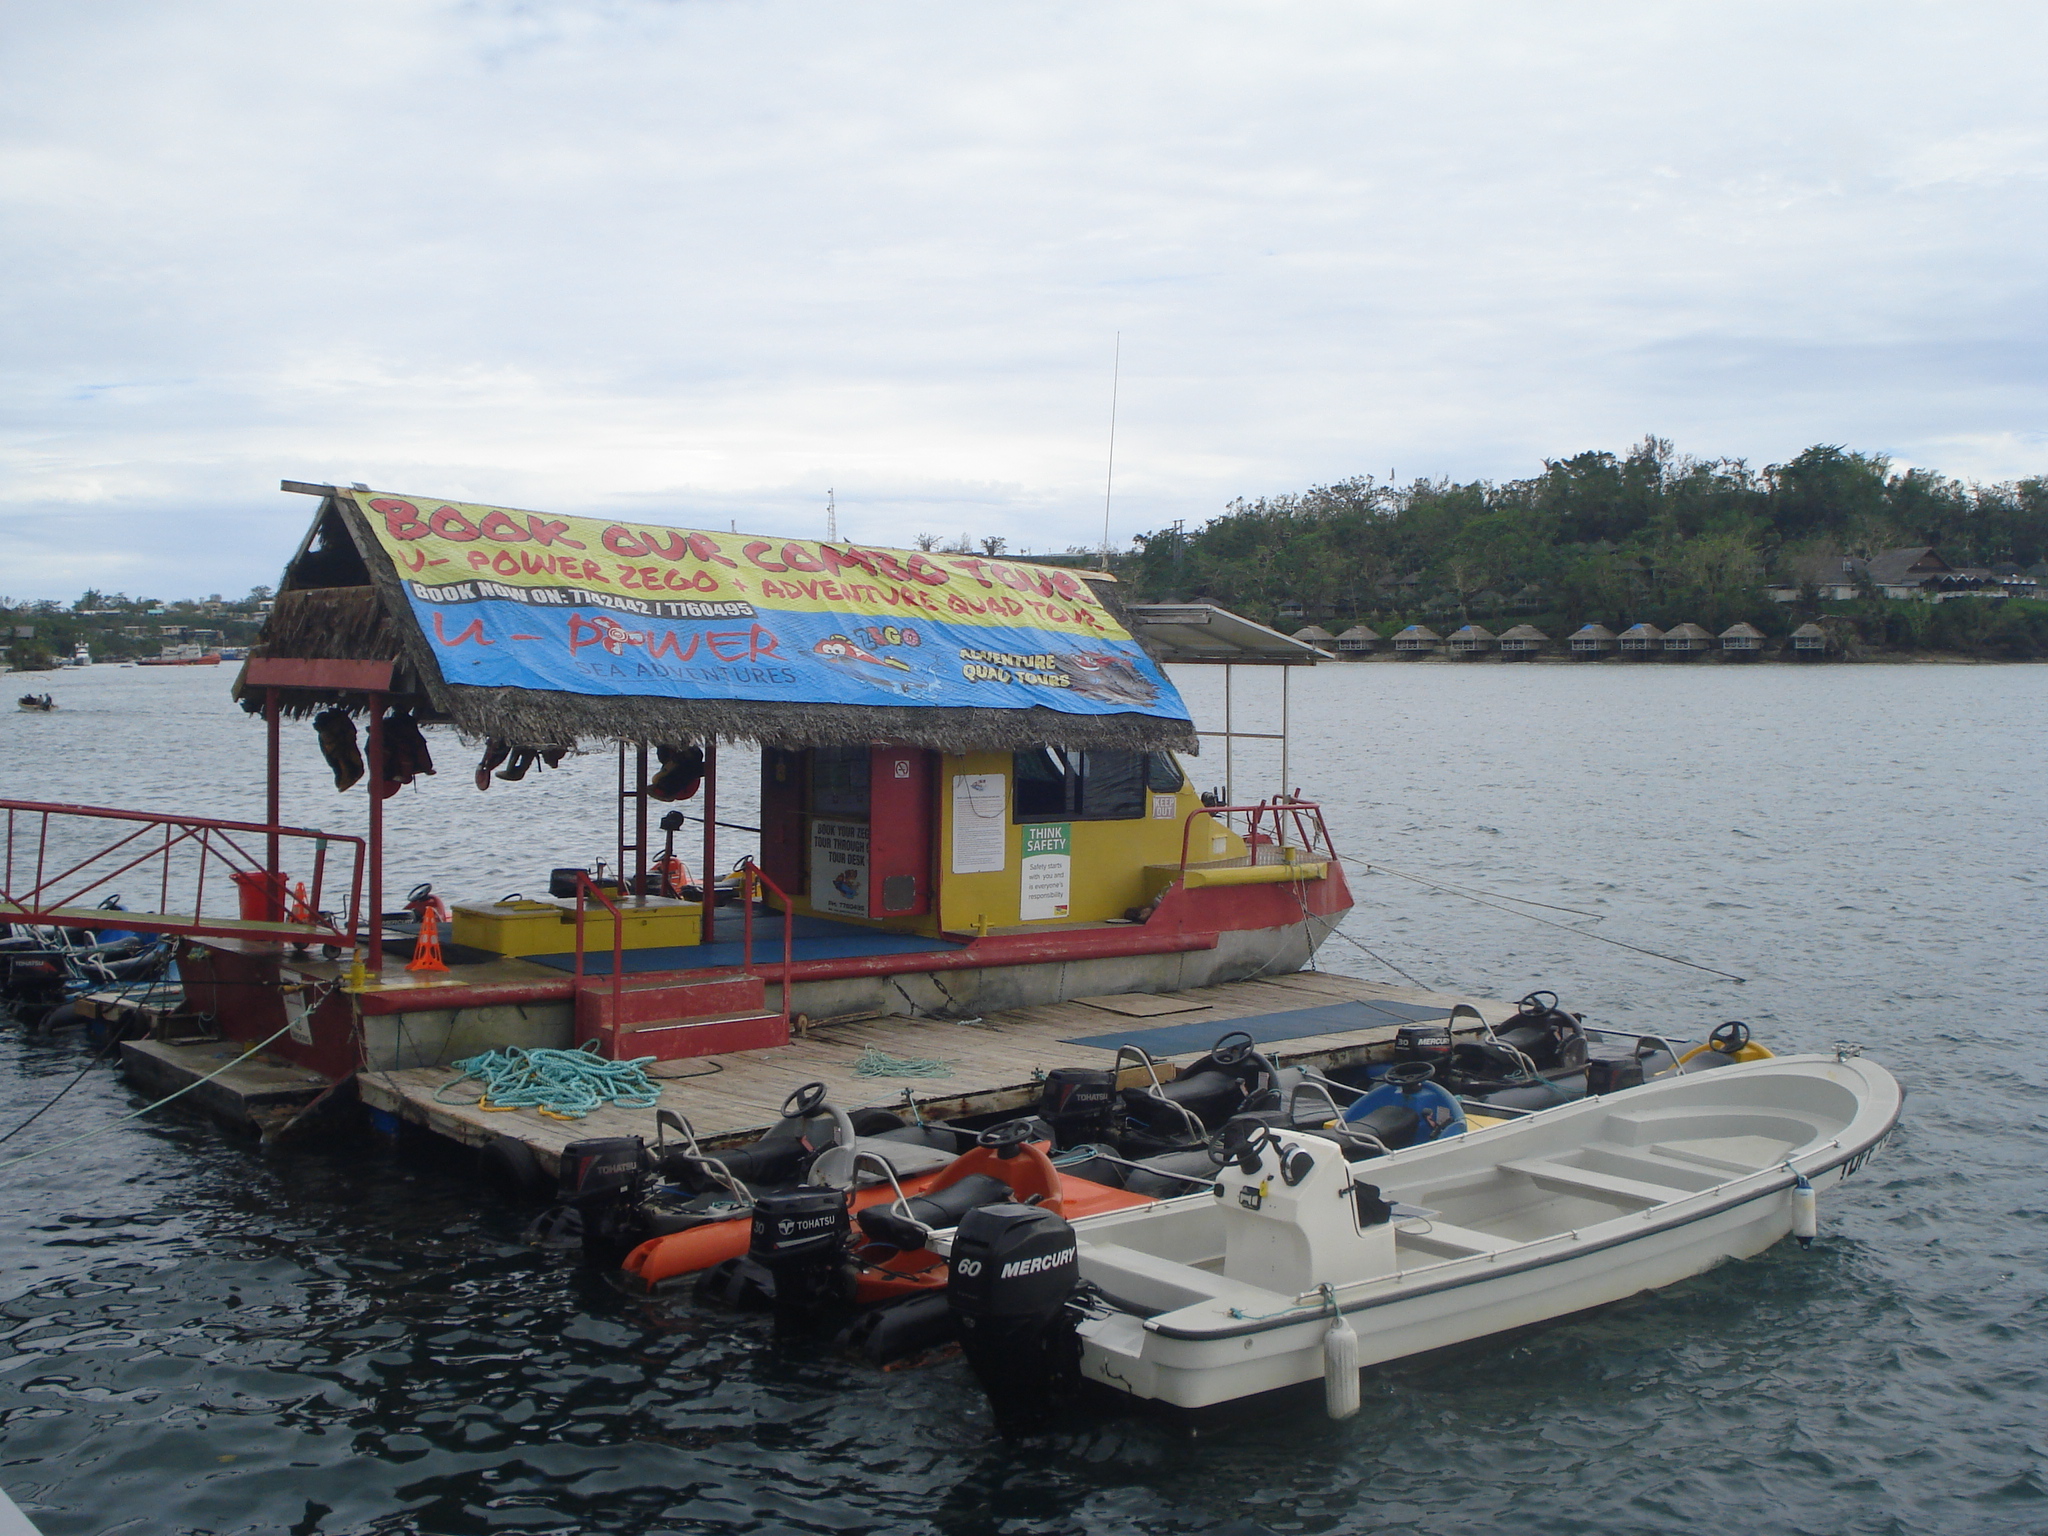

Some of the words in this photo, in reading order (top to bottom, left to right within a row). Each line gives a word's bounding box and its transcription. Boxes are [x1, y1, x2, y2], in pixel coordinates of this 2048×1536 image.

[369, 498, 587, 551] BOOK
[601, 525, 738, 568] OUR
[743, 540, 949, 586] COMBO
[948, 558, 1097, 605] TOUR
[467, 550, 610, 584] POWER
[617, 564, 719, 593] ZEGO
[762, 578, 938, 612] ADVENTURE
[947, 593, 1024, 617] QUAD
[1025, 600, 1105, 631] TOUR
[412, 582, 476, 603] BOOK
[476, 581, 529, 602] NOW
[530, 588, 569, 604] ON:
[568, 588, 652, 616] 7742442
[664, 602, 754, 617] 7760495
[853, 625, 922, 651] ZEGO
[959, 648, 1056, 670] ADVENTURE
[575, 661, 627, 677] SEA
[637, 662, 797, 683] ADVENTURES
[963, 664, 1013, 683] QUAD
[1015, 671, 1072, 687] TOURS
[1155, 797, 1175, 807] KEEP
[1156, 807, 1172, 816] OUT
[817, 823, 836, 836] BOOK
[838, 825, 855, 838] YOUR
[857, 827, 870, 839] ZEG
[1029, 827, 1062, 840] THINK
[814, 836, 831, 849] TOUR
[834, 838, 865, 852] THROUGH
[1027, 838, 1066, 852] SAFETY
[828, 851, 846, 864] TOUR
[847, 853, 865, 867] DESK
[1029, 863, 1047, 871] Safety
[1034, 882, 1063, 890] everyone's
[1028, 892, 1063, 900] responsibility
[1418, 1037, 1450, 1046] MERCUR
[1076, 1093, 1108, 1101] TOHATSU
[597, 1161, 637, 1174] TOHATSU
[754, 1221, 764, 1235] 30
[797, 1215, 835, 1230] TOHATSU
[958, 1258, 982, 1277] 60
[1001, 1246, 1076, 1279] MERCURY
